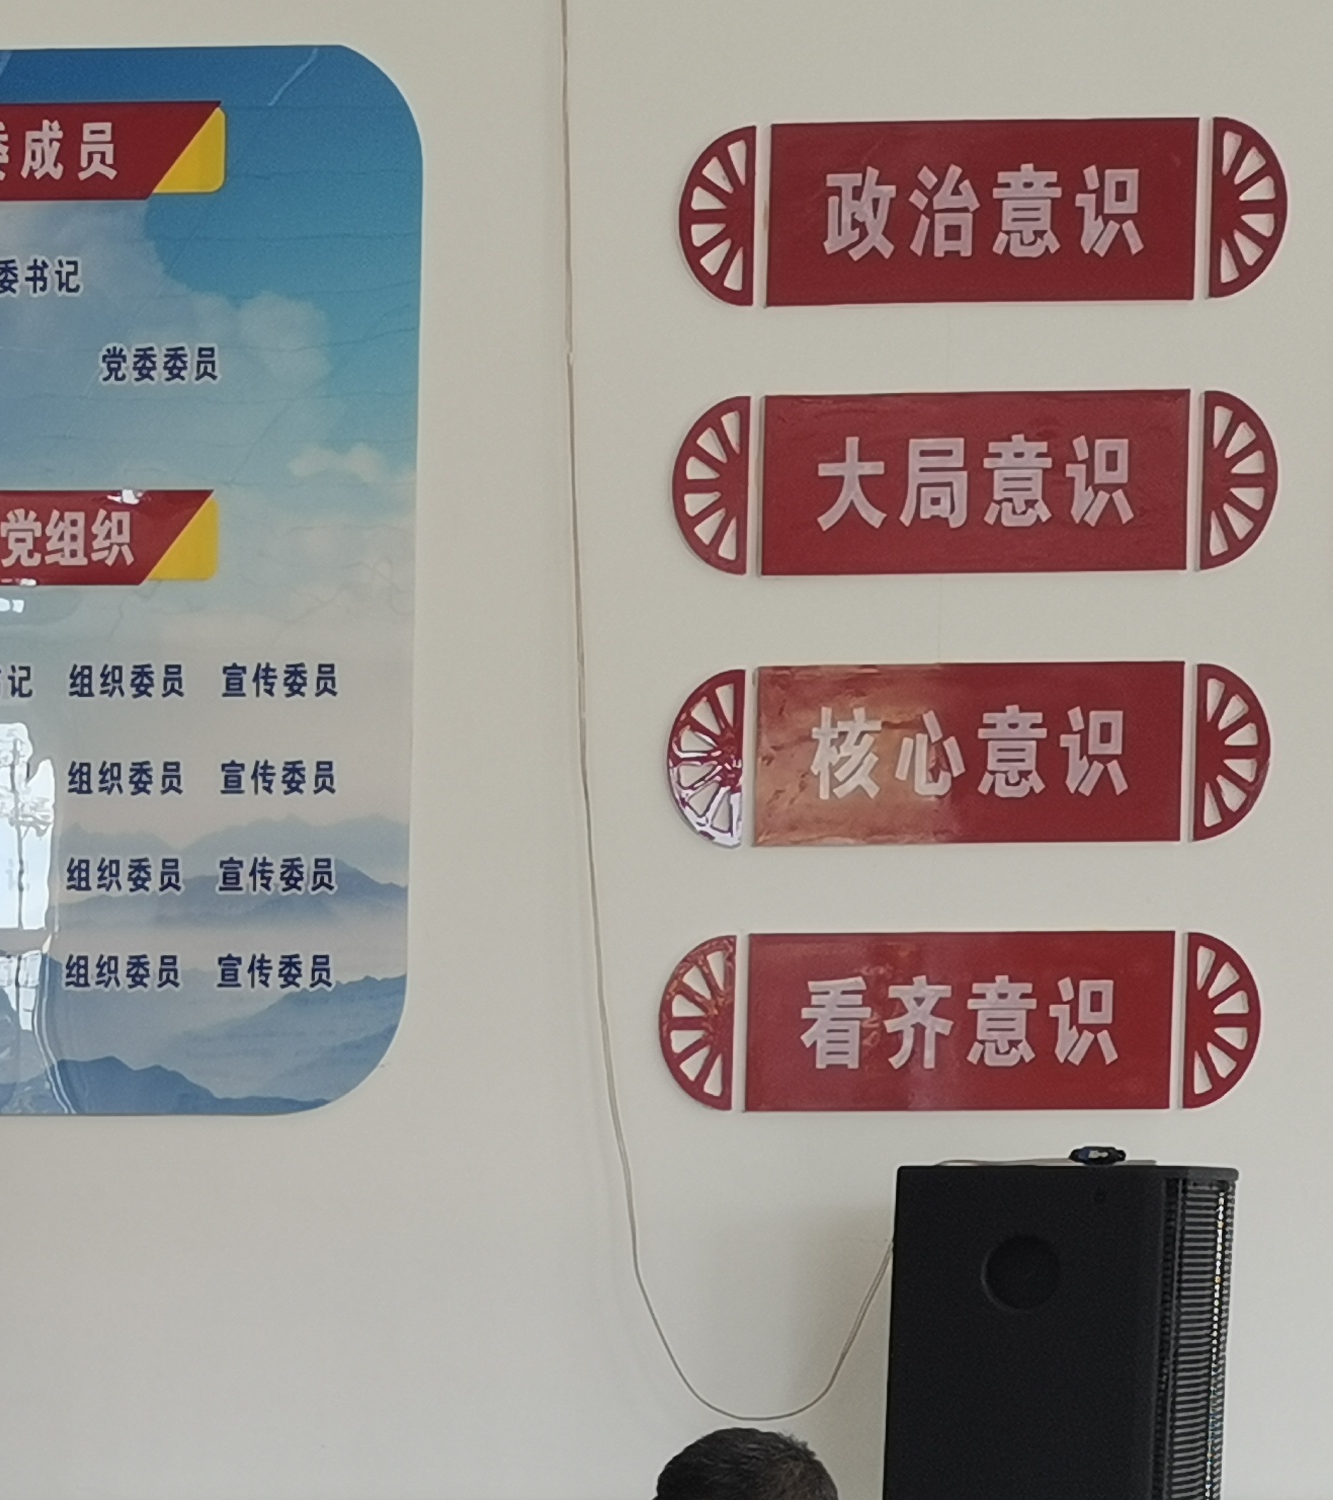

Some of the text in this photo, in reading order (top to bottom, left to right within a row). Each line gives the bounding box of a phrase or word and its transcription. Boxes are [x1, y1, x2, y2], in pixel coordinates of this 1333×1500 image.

[823, 163, 1144, 261] 政治意识
[101, 346, 219, 383] 党委委员
[817, 434, 1136, 530] 大局意识
[68, 663, 186, 699] 组织委员
[222, 662, 339, 699] 宣传委员
[809, 704, 1129, 801] 核心意识
[67, 760, 185, 797] 组织委员
[220, 759, 337, 797] 宣传委员
[66, 856, 183, 893] 组织委员
[218, 855, 336, 893] 宣传委员
[65, 953, 182, 990] 组织委员
[216, 952, 334, 990] 宣传委员
[800, 975, 1119, 1069] 看齐意识
